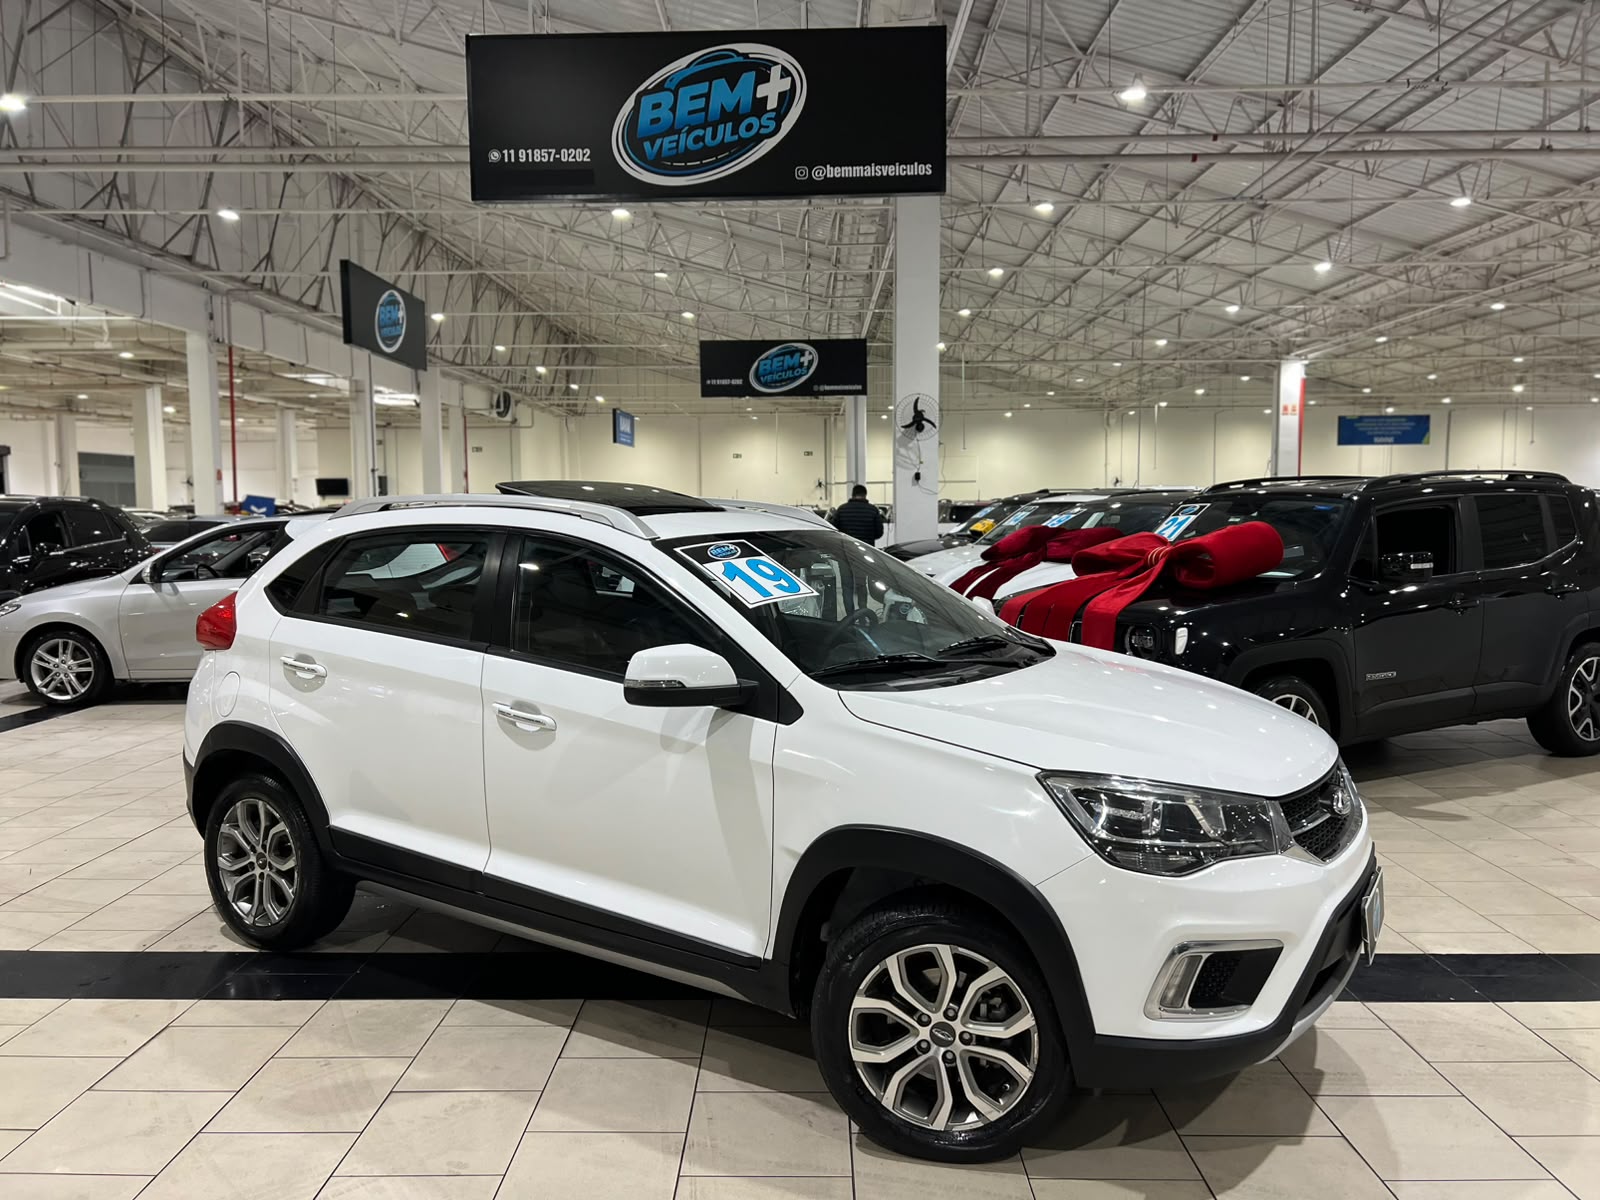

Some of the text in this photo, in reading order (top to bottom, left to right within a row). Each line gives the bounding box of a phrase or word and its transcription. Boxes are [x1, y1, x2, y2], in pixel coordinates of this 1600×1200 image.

[643, 111, 777, 161] VEÍCULOS
[502, 148, 591, 163] 11 91857-0202
[811, 161, 933, 181] @bemmaisveiculos
[1157, 516, 1192, 540] 21
[721, 558, 801, 598] 19
